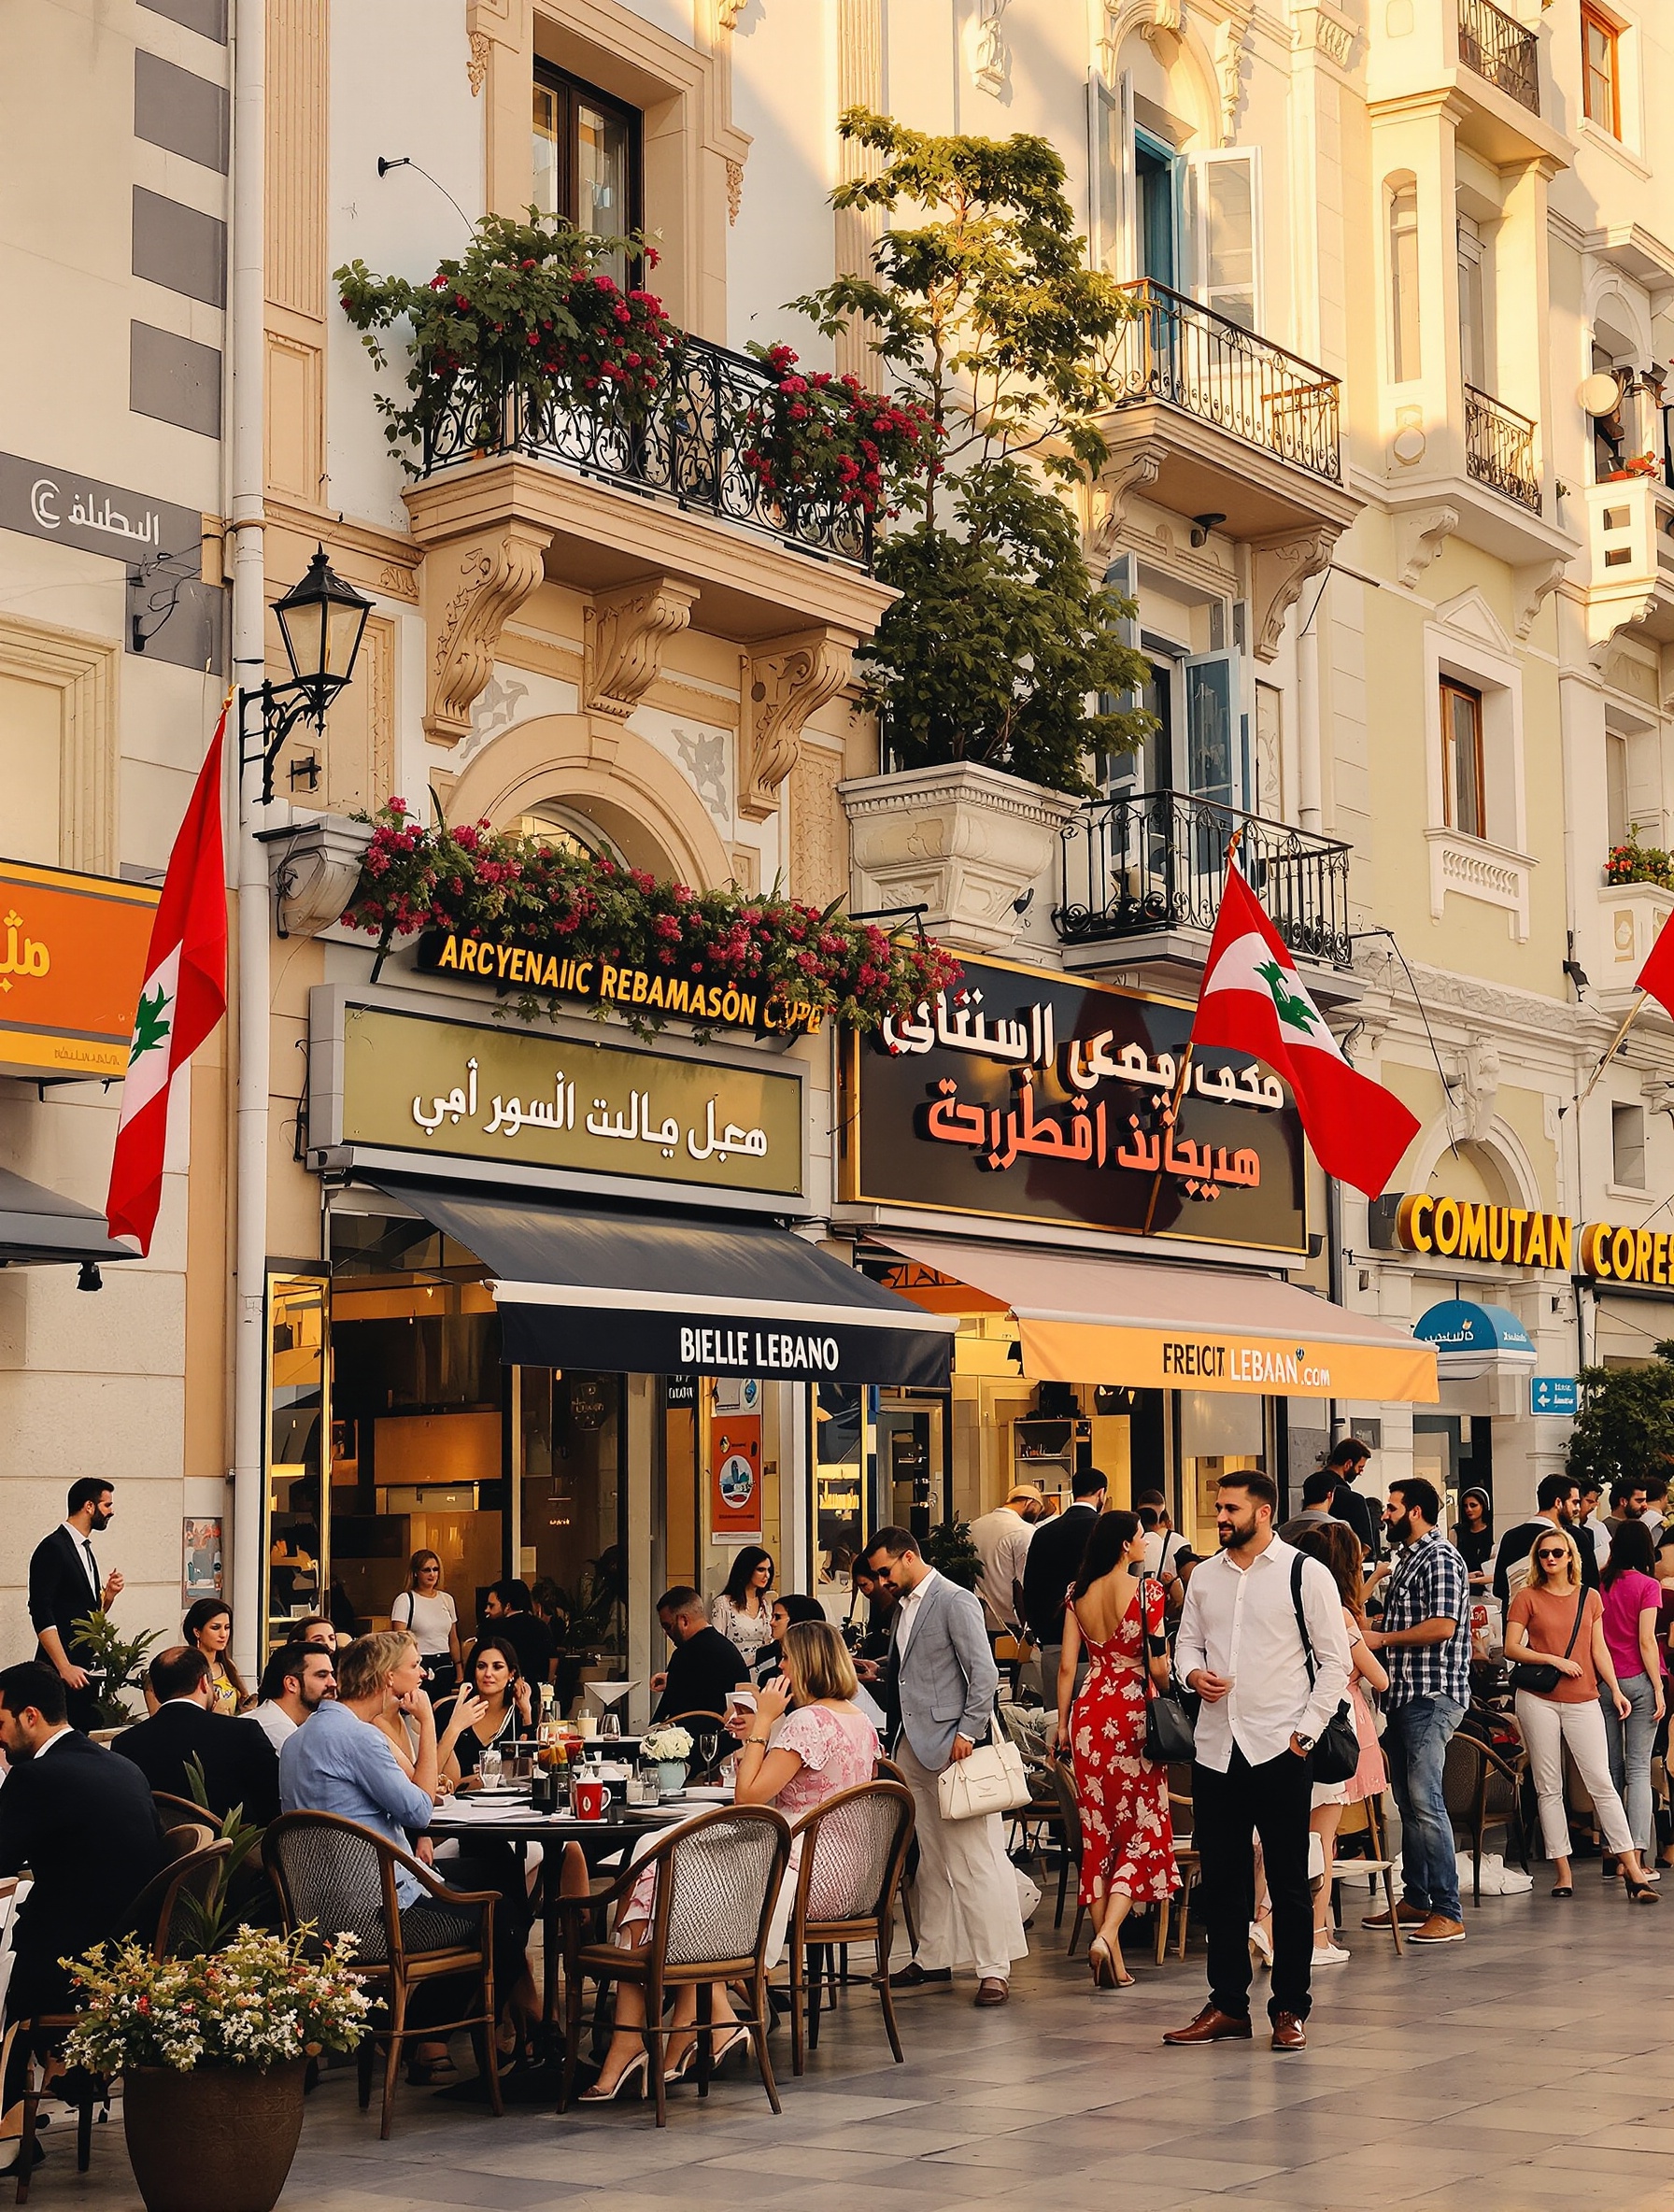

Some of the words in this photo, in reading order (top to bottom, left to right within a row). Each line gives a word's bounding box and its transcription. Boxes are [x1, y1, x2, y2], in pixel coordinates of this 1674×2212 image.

[1409, 1192, 1572, 1271] COMUTAN
[680, 1326, 748, 1366] BIELLE
[755, 1332, 840, 1371] LEBANO
